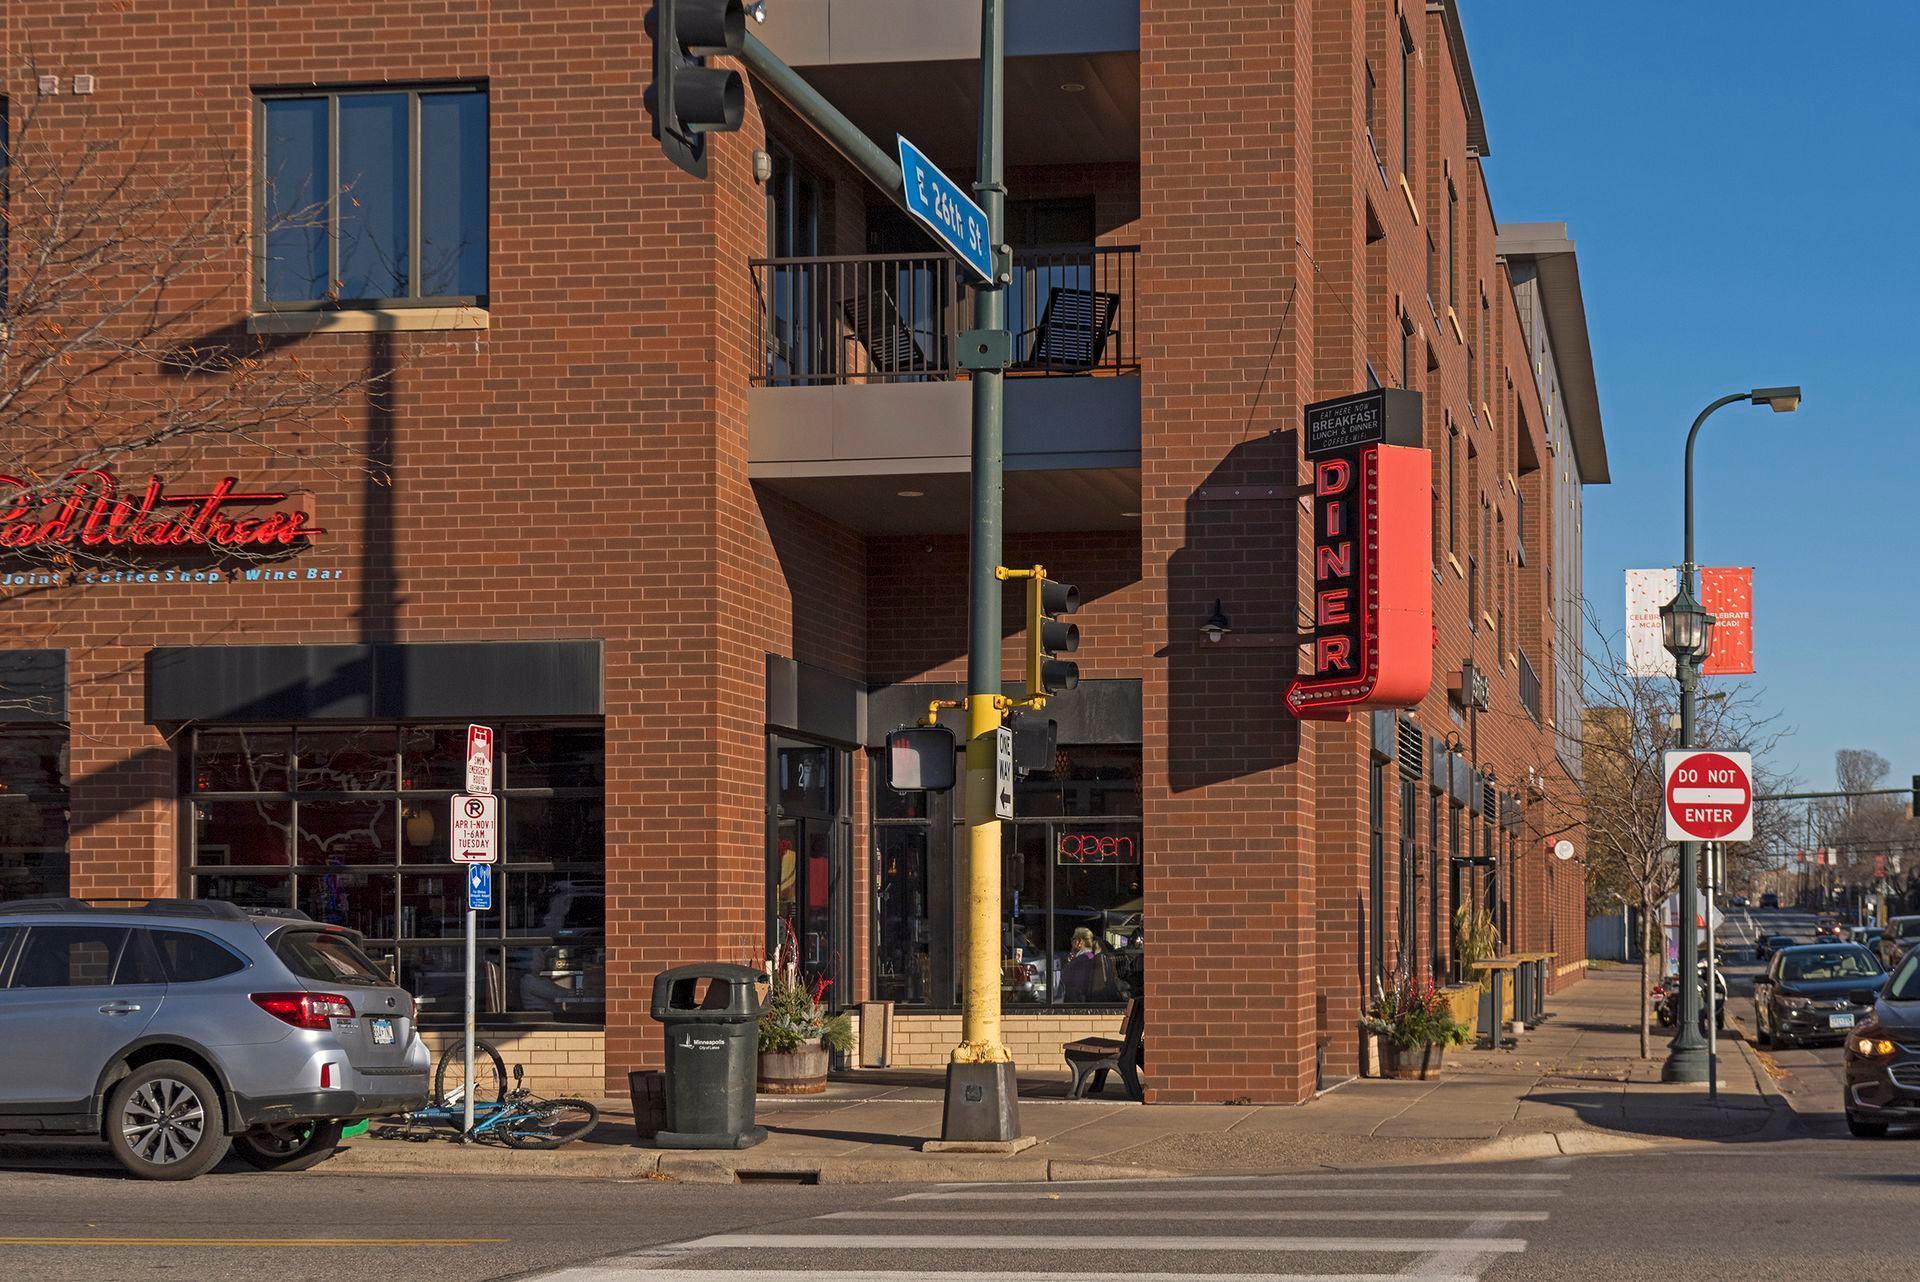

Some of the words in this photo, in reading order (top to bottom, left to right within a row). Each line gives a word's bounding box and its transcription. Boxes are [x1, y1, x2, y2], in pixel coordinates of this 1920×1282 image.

[916, 166, 929, 206] E
[932, 182, 964, 240] 26th
[968, 216, 983, 256] St
[1312, 408, 1379, 433] BREAKFAST
[1321, 409, 1332, 420] EAT
[1334, 406, 1352, 417] HERE
[1312, 429, 1338, 441] LUNCH
[1340, 427, 1347, 435] &
[1349, 420, 1378, 433] DINNER
[1316, 457, 1351, 673] DINER
[246, 568, 298, 582] Wine
[306, 567, 343, 580] Bar
[999, 733, 1011, 757] ONE
[999, 759, 1011, 782] WAY
[1678, 769, 1698, 783] DO
[1708, 769, 1736, 783] NOT
[455, 820, 469, 829] APR
[1685, 808, 1733, 823] ENTER
[458, 839, 490, 848] TUESDAY
[463, 830, 485, 839] 1-6AM
[1061, 834, 1133, 863] open
